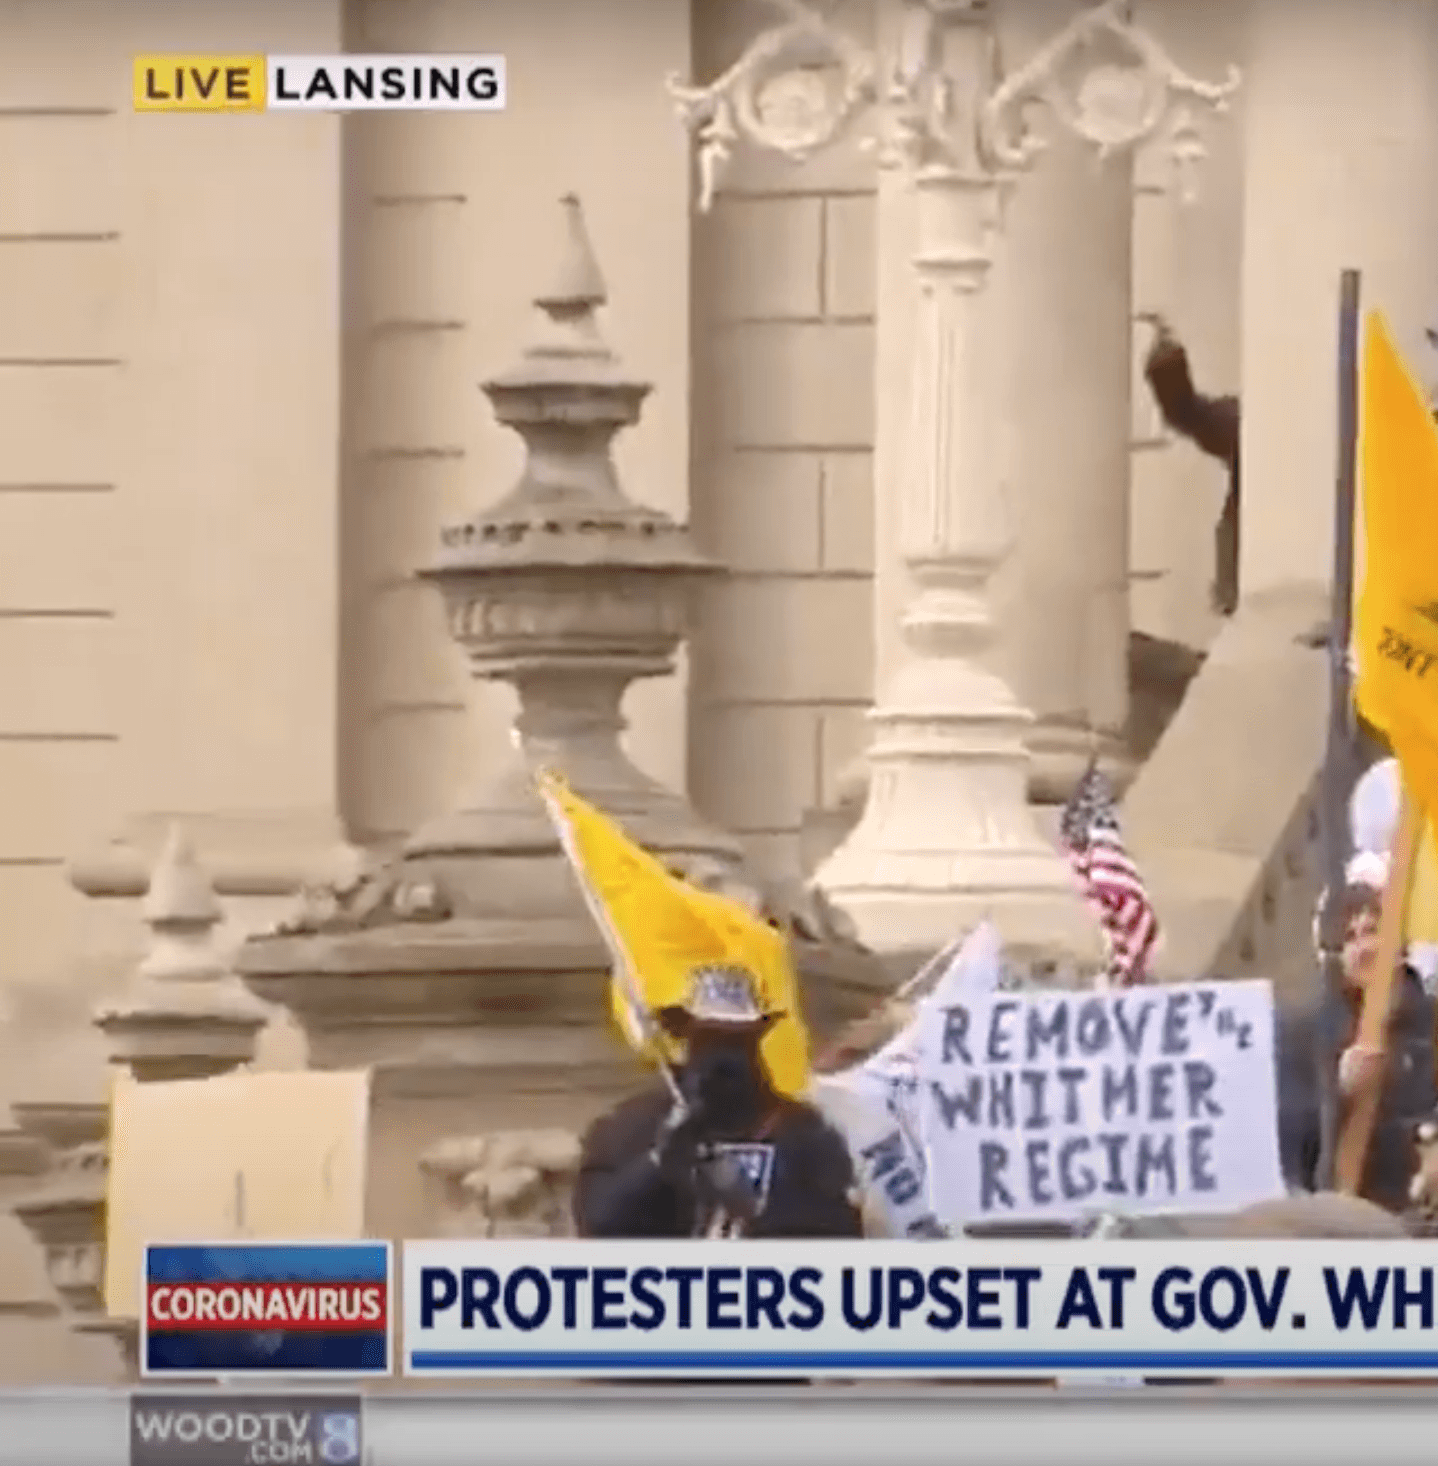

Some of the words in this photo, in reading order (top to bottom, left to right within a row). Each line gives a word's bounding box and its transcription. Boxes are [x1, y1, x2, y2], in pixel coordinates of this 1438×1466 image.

[940, 991, 1191, 1066] REMOVE
[931, 1060, 1224, 1130] WHITMER
[979, 1125, 1218, 1212] REGIME
